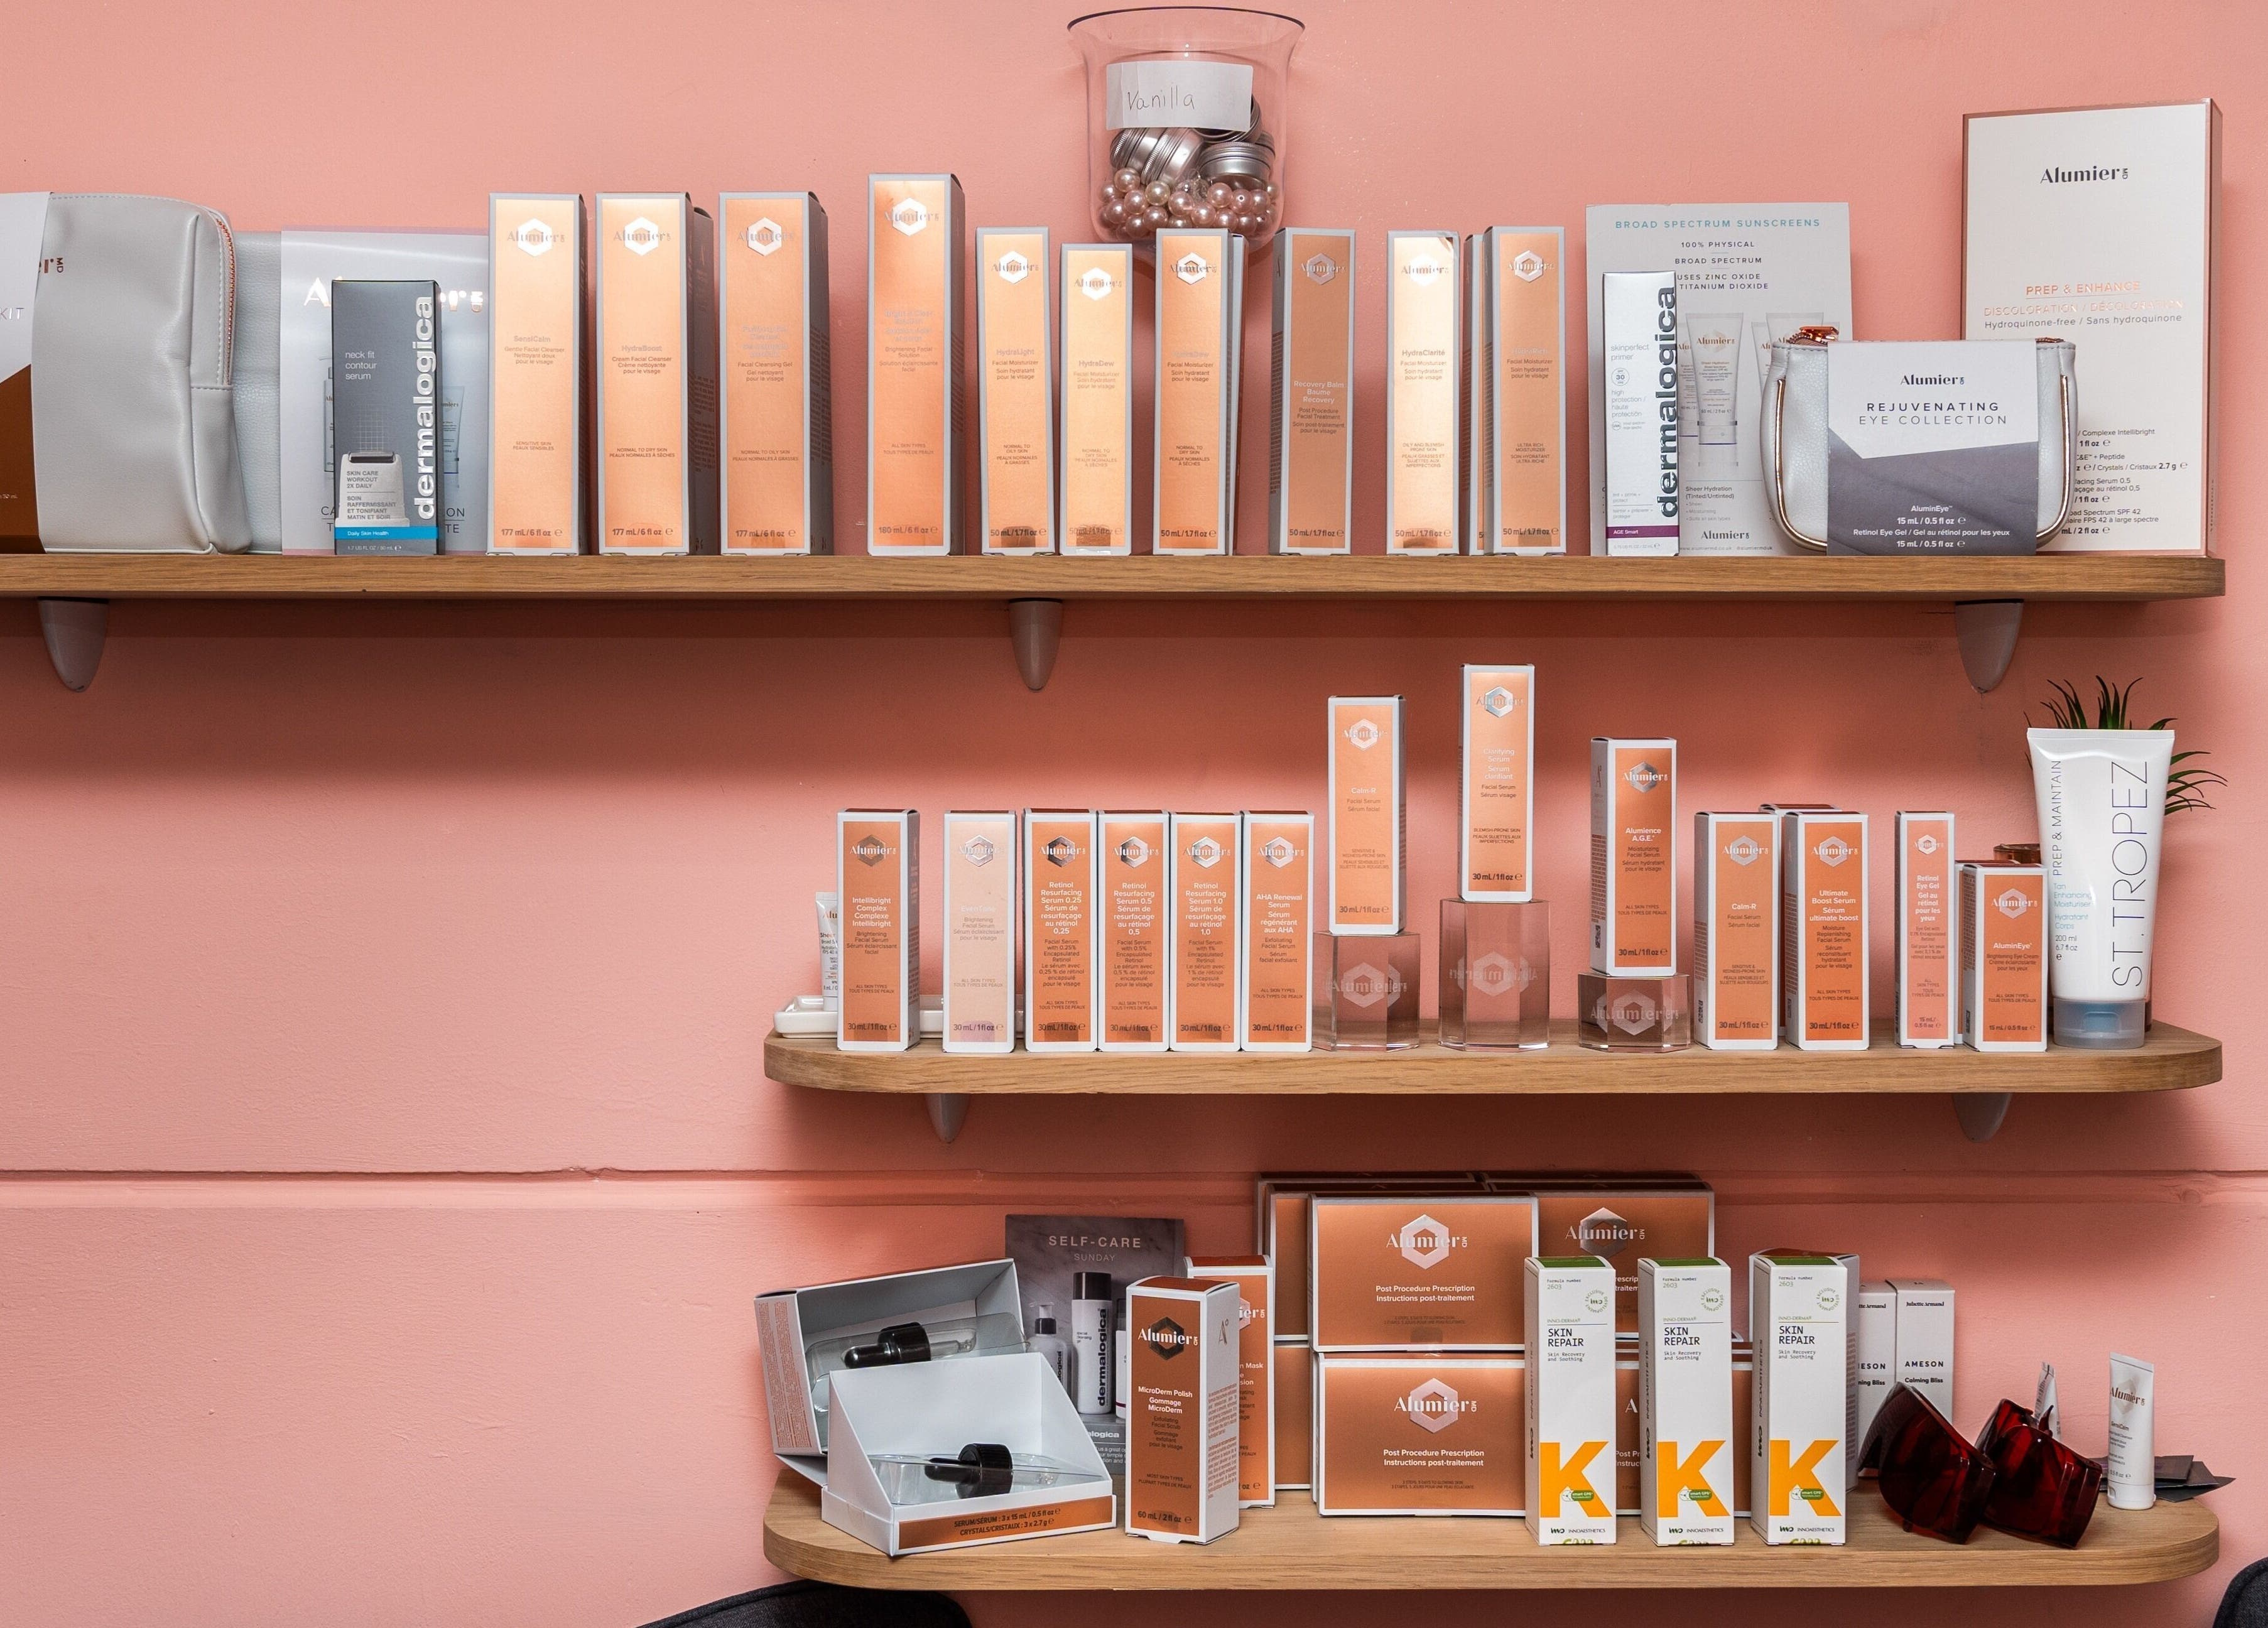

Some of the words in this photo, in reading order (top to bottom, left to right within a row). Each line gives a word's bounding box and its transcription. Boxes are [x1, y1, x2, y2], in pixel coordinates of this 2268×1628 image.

[1127, 84, 1195, 112] Vanilla
[2040, 166, 2120, 184] Alumier
[1615, 220, 1658, 229] BROAD
[1664, 220, 1731, 228] SPECTRUM
[1737, 219, 1820, 227] SUNSCREENS
[2026, 285, 2058, 295] PREP
[2064, 285, 2071, 294] &
[2076, 281, 2140, 293] ENHANCE
[1984, 304, 2077, 316] DISCOLORATION
[1985, 317, 2075, 329] Hydroquinone-free
[2086, 316, 2109, 325] Sans
[2113, 313, 2182, 324] hydroquinone
[1610, 343, 1649, 352] skinperfect
[345, 350, 366, 359] neck
[367, 350, 376, 359] fit
[1401, 349, 1445, 357] HydraClarité
[1610, 353, 1634, 362] primer
[345, 361, 377, 370] contour
[1293, 381, 1325, 389] Recovery
[1901, 375, 1958, 386] Alumier
[1303, 396, 1335, 404] Recovery
[1654, 286, 1679, 518] dermalogica
[412, 296, 436, 520] dermalogica
[1867, 402, 1999, 411] REJUVENATING
[1859, 416, 1889, 425] EYE
[1899, 415, 2007, 425] COLLECTION
[1897, 517, 1906, 525] 15
[1924, 517, 1938, 525] 0.5
[1701, 530, 1745, 540] Alumier
[1880, 529, 1893, 538] Eye
[1937, 528, 1961, 536] rétinol
[2051, 760, 2062, 827] MAINTAIN
[2052, 832, 2062, 840] &
[2111, 761, 2147, 928] TROPEZ
[2052, 844, 2063, 876] PREP
[1041, 889, 1082, 897] Resurfacing
[2054, 891, 2092, 900] Enhancing
[856, 904, 887, 913] Complex
[1041, 912, 1082, 920] resurfaçage
[852, 920, 891, 928] Intellibright
[1260, 919, 1298, 927] régénérant
[1565, 1225, 1637, 1240] Alumier
[1048, 1235, 1141, 1248] SELF-CARE
[1386, 1232, 1460, 1249] Alumier
[1074, 1254, 1115, 1262] SUNDAY
[1375, 1284, 1391, 1293] Post
[1392, 1284, 1430, 1293] Procedure
[1431, 1284, 1475, 1294] Prescription
[1376, 1294, 1419, 1302] Instructions
[1420, 1294, 1475, 1303] post-traitement
[1548, 1328, 1573, 1337] SKIN
[1664, 1327, 1689, 1336] SKIN
[1779, 1326, 1803, 1335] SKIN
[1137, 1328, 1193, 1345] Alumier
[1664, 1336, 1700, 1346] REPAIR
[1779, 1335, 1815, 1345] REPAIR
[1548, 1337, 1584, 1347] REPAIR
[1097, 1308, 1107, 1407] dermalogica
[1138, 1386, 1173, 1396] MicroDerm
[1173, 1389, 1193, 1398] Polish
[1149, 1397, 1181, 1407] Gommage
[1394, 1396, 1469, 1413] Alumier
[1148, 1404, 1183, 1414] MicroDerm
[1383, 1449, 1399, 1457] Post
[1401, 1449, 1438, 1457] Procedure
[1440, 1448, 1484, 1458] Prescription
[1384, 1458, 1427, 1467] Instructions
[1428, 1458, 1484, 1467] post-traitement
[1539, 1441, 1613, 1518] K
[1658, 1440, 1731, 1518] K
[1769, 1440, 1842, 1516] K
